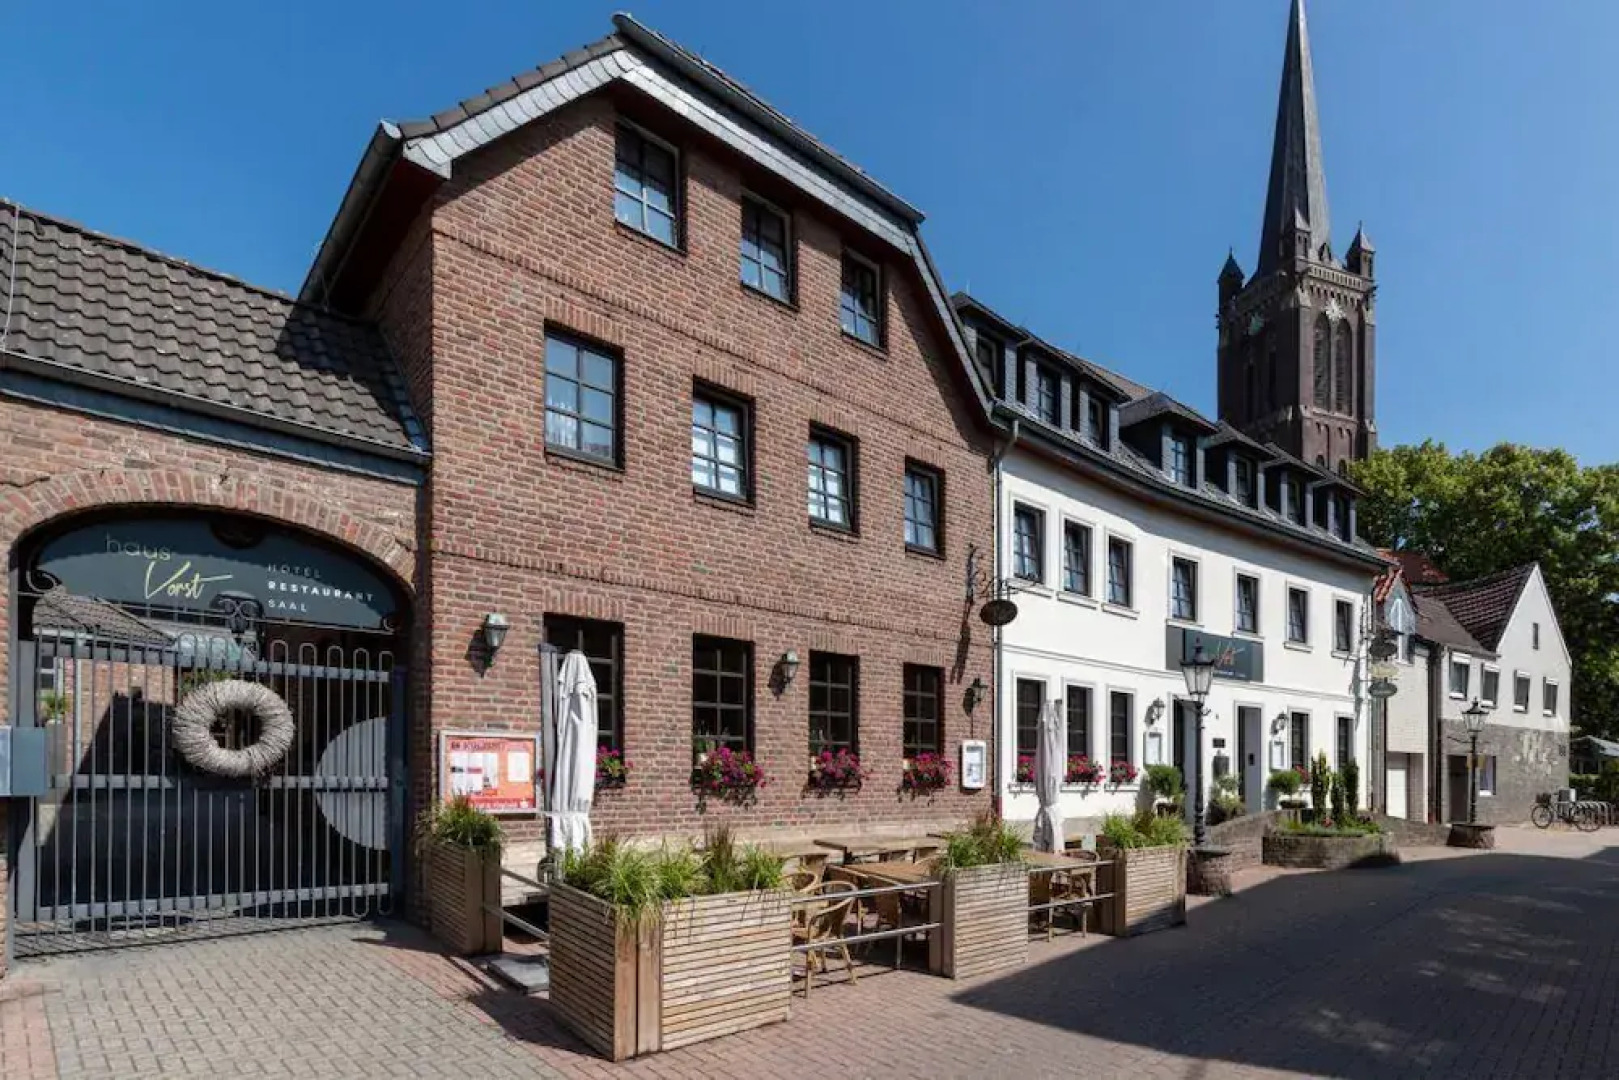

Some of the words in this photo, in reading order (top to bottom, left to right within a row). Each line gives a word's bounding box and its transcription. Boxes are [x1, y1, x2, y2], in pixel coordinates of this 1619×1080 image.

[105, 533, 171, 561] haus
[144, 560, 233, 600] Vorst
[267, 563, 321, 579] HOTEL
[267, 580, 374, 602] RESTAURANT
[267, 598, 308, 613] SAAL
